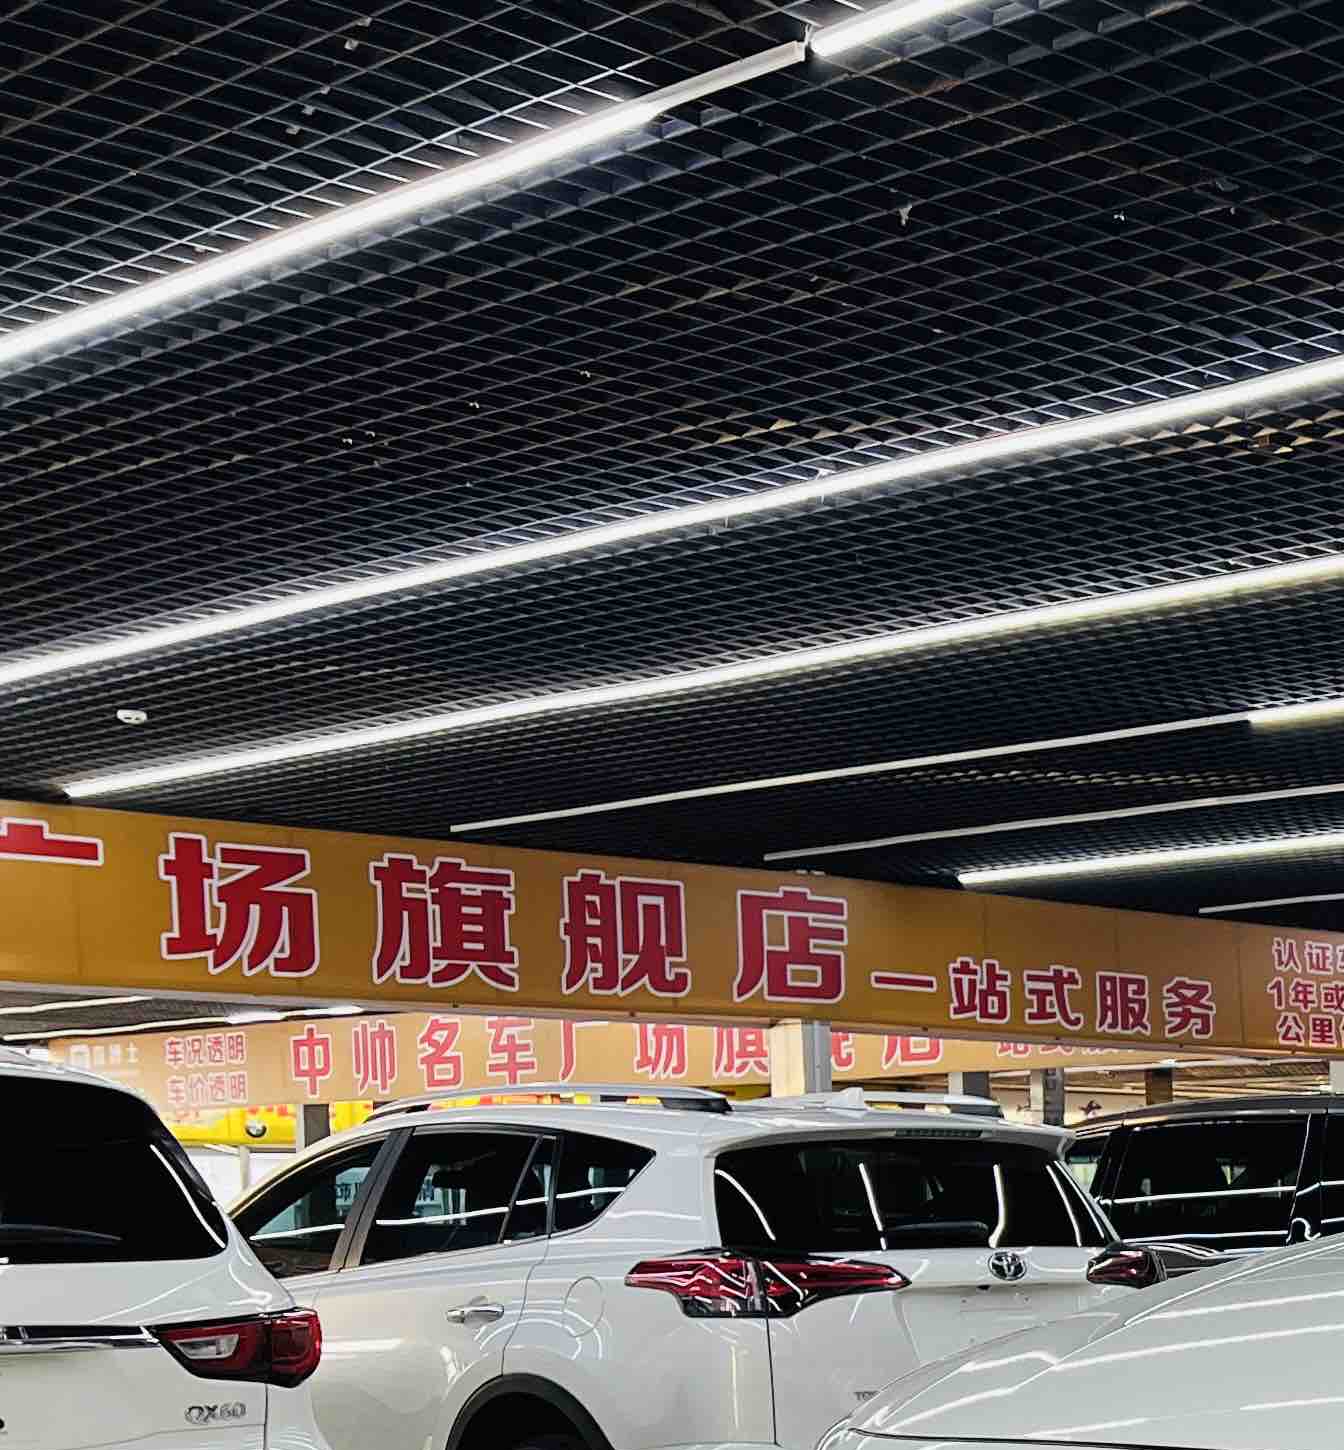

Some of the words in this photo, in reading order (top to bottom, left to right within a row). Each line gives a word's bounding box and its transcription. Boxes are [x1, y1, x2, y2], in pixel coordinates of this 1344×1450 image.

[871, 958, 1216, 1039] 一站式服务
[165, 1032, 246, 1067] 车况透明
[167, 1070, 247, 1104] 车价透明
